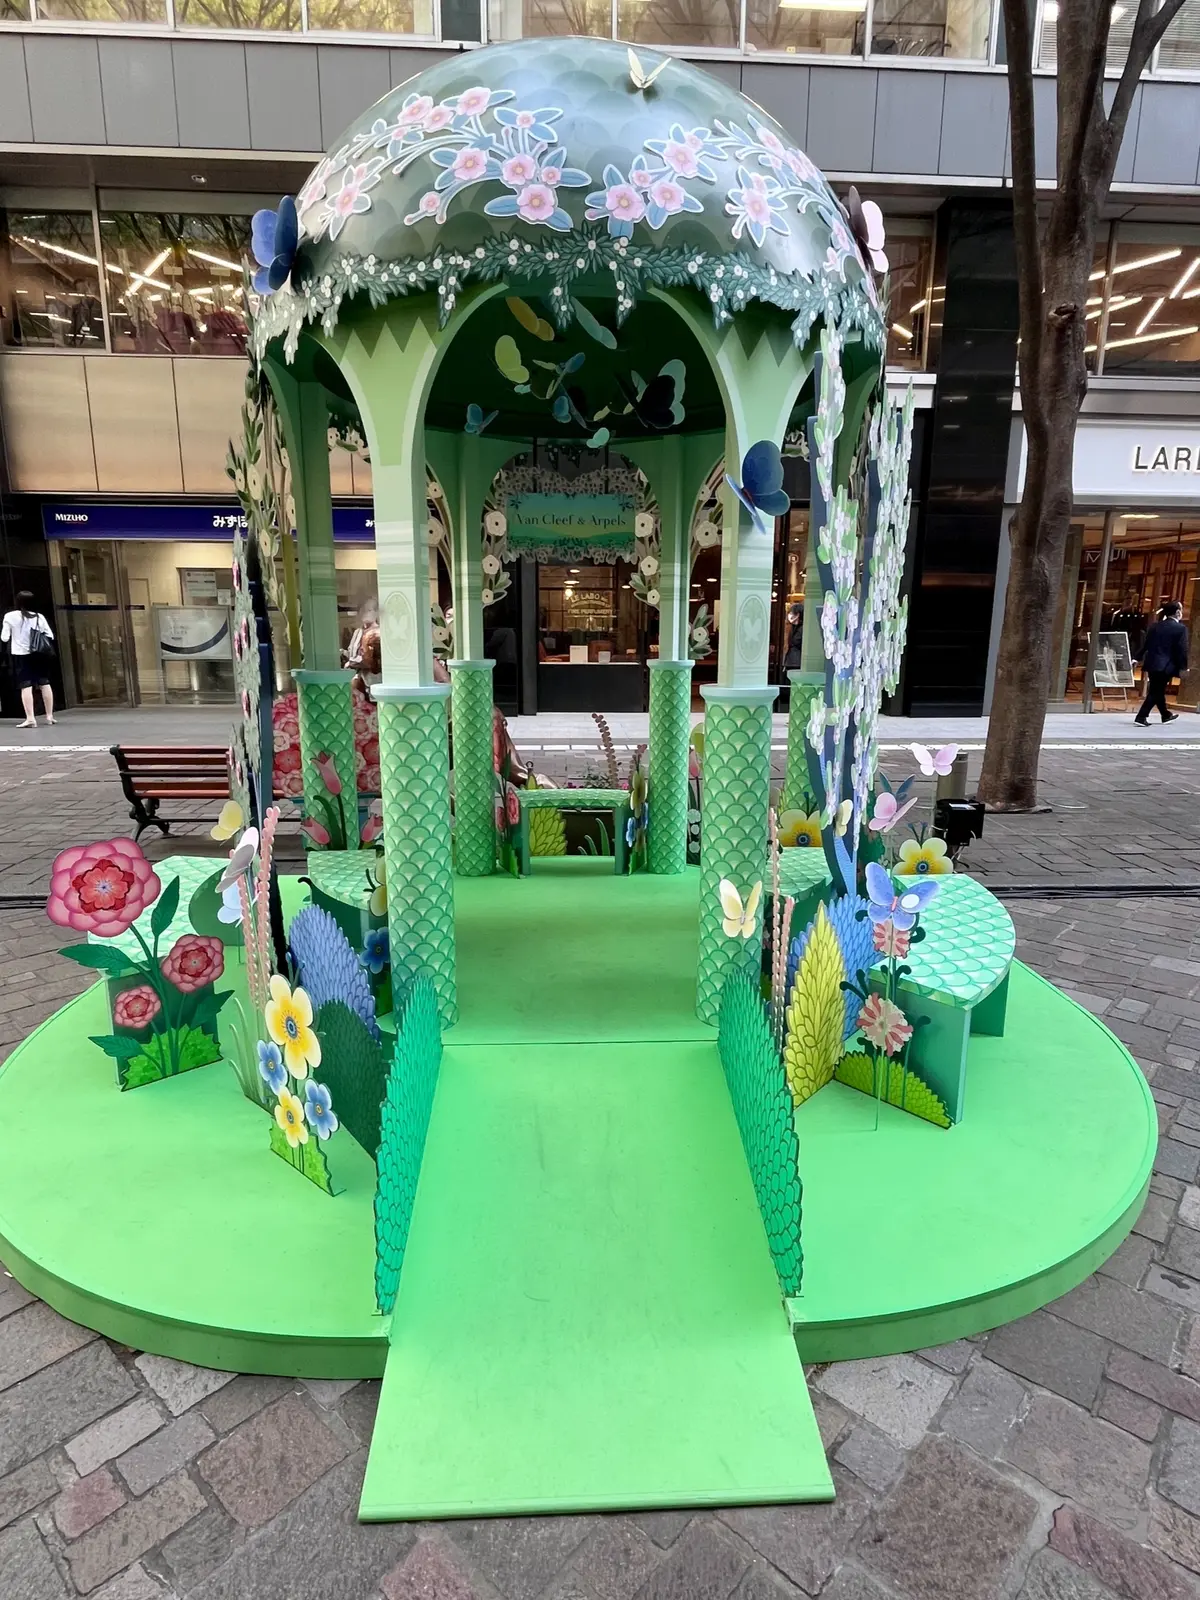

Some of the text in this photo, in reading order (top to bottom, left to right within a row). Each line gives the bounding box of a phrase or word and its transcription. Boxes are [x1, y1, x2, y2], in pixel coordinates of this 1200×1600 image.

[1134, 446, 1200, 470] LAR
[55, 513, 89, 522] MIZUHO
[516, 513, 627, 529] Van Cleef & Arpels
[580, 592, 601, 600] LABO
